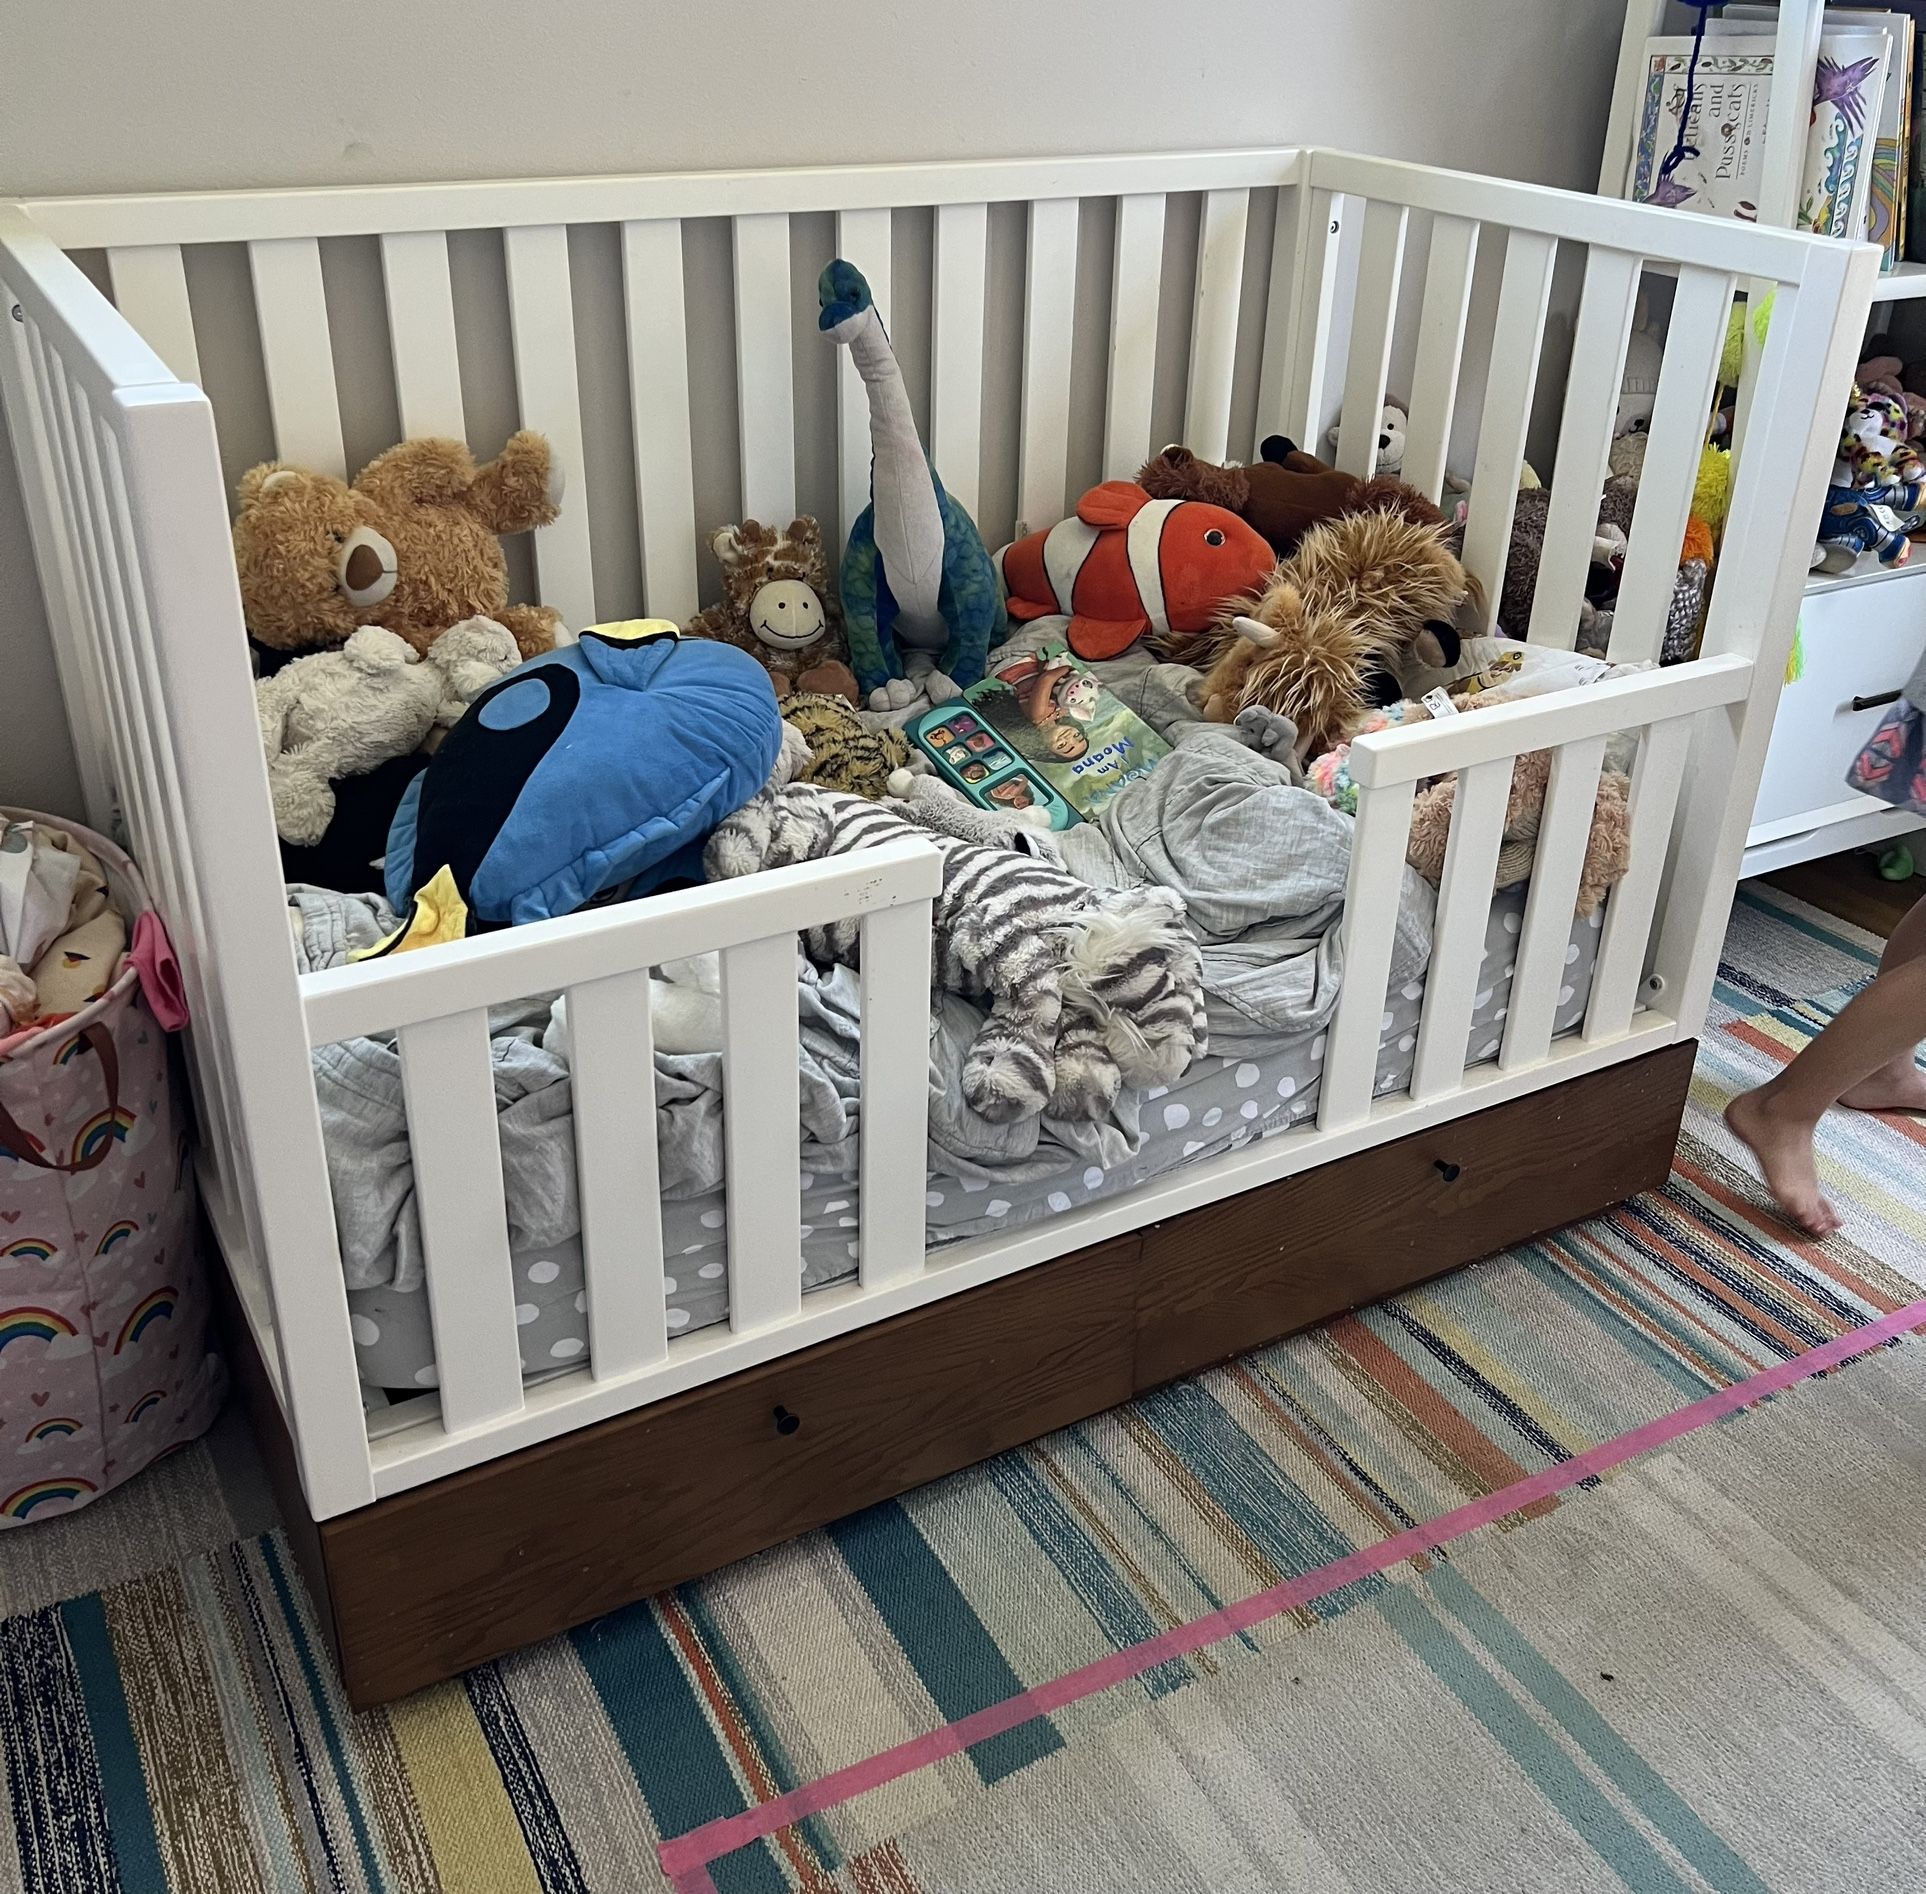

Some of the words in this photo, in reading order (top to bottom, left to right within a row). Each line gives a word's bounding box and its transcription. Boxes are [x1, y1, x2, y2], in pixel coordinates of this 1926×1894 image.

[1707, 83, 1725, 118] and
[1740, 149, 1749, 176] POEMS
[1748, 83, 1759, 128] LIMERICKS
[1071, 736, 1135, 774] Moana
[1097, 760, 1119, 774] Am
